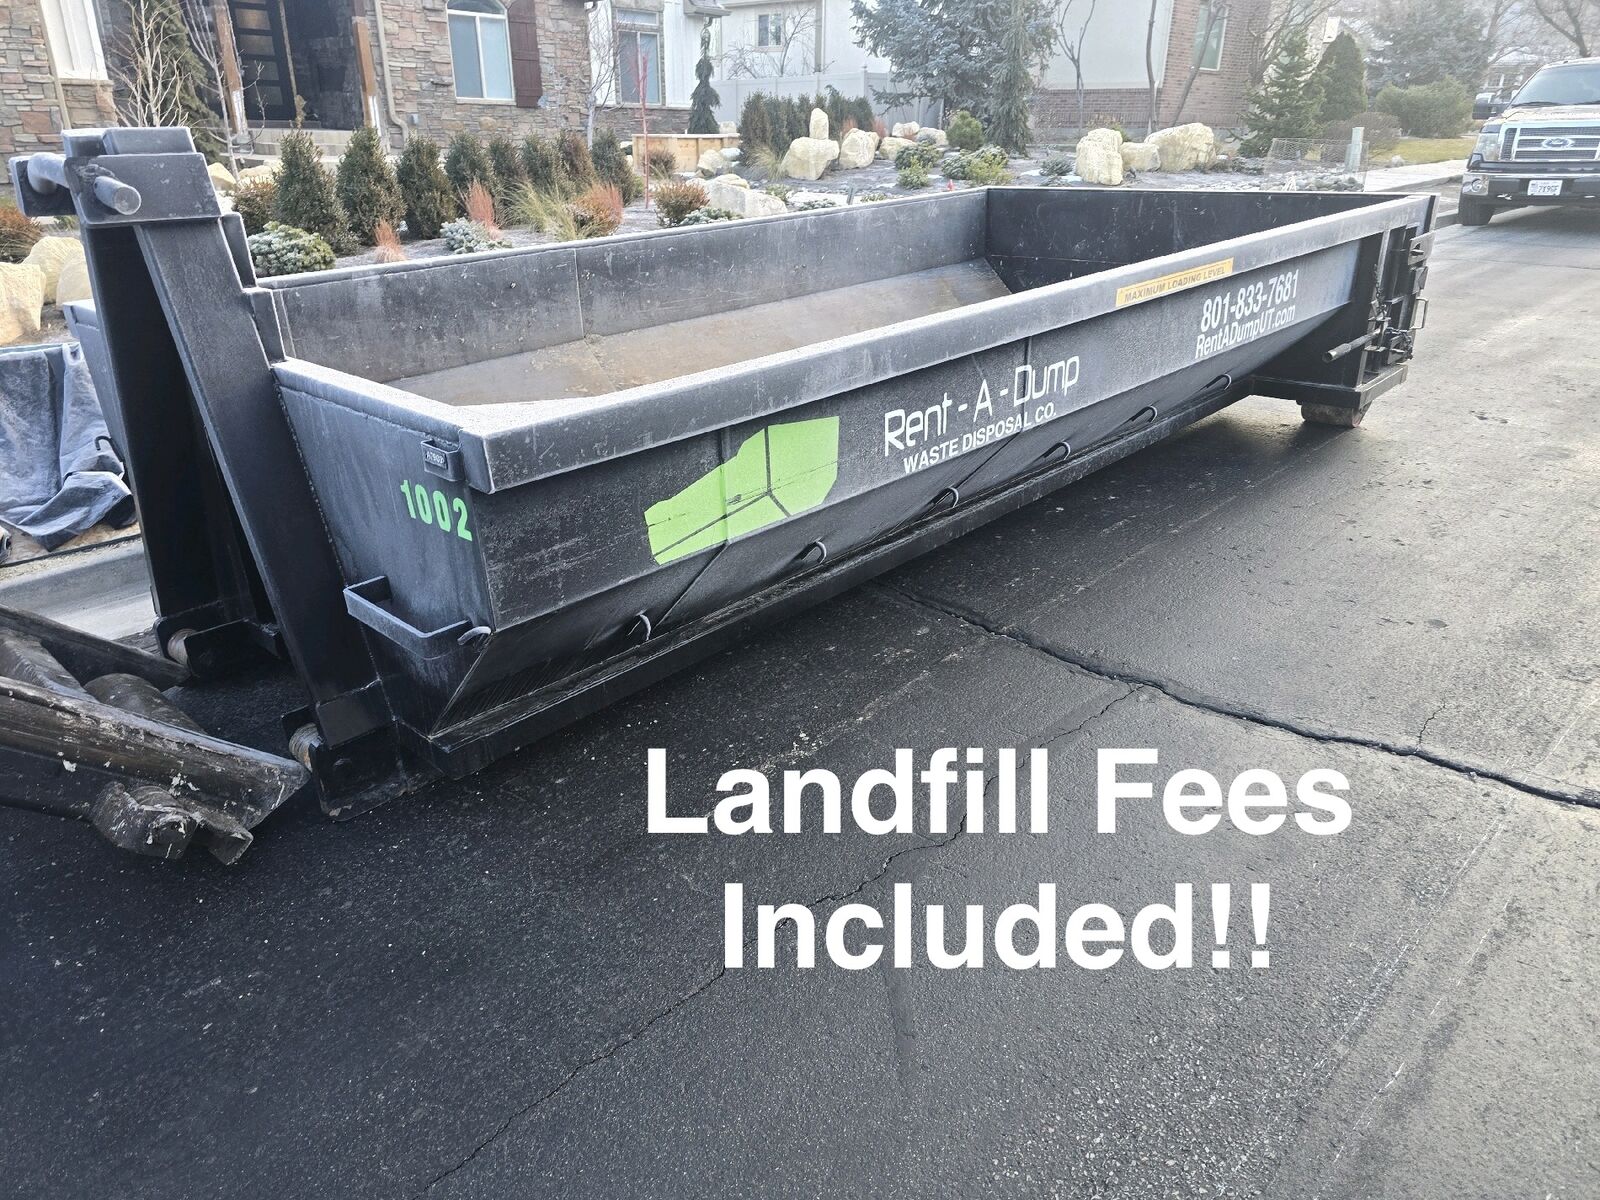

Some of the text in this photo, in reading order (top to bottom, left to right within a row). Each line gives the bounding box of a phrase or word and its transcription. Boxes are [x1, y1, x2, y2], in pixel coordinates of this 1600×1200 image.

[1124, 266, 1225, 302] MAXIMUM LOADING LEVEL
[1200, 269, 1300, 332] 801-833-7681
[1195, 305, 1297, 359] RentADumpUT.com
[903, 402, 1058, 475] WASTE DISPOSAL CO.
[400, 479, 473, 541] 1002
